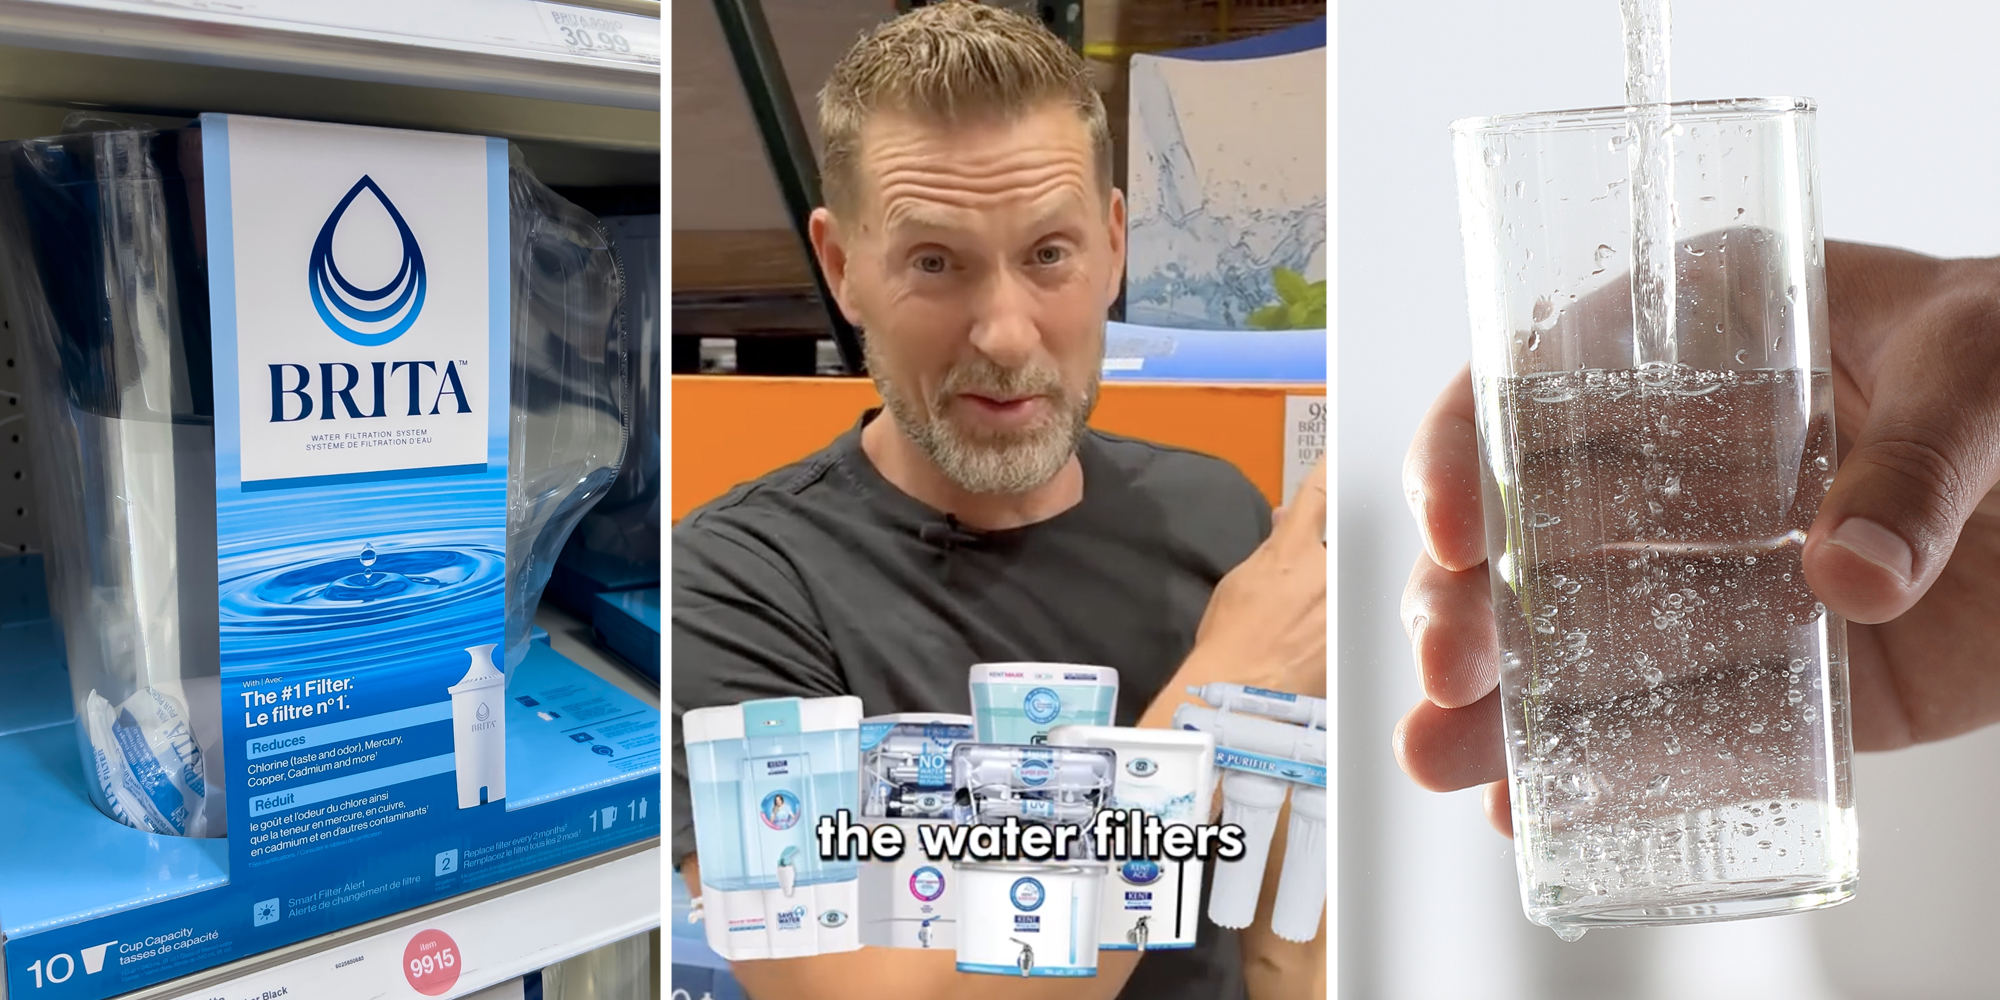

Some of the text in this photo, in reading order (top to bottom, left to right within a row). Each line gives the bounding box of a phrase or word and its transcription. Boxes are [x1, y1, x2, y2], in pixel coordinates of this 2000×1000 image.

[560, 26, 631, 52] 30.99
[306, 440, 345, 451] SYSTÈME
[348, 440, 358, 448] DE
[361, 438, 407, 447] FILTRATION
[311, 429, 427, 442] WATER FILTRATION SYSTEM
[242, 680, 260, 688] With
[265, 676, 283, 684] Avec
[240, 690, 278, 708] The
[281, 684, 301, 701] #1
[246, 712, 268, 728] Le
[272, 704, 313, 723] filtre
[248, 735, 403, 775] Chlorine (taste and odor), Mercury,
[252, 736, 306, 754] Reduces
[98, 748, 110, 781] FILTER
[247, 773, 286, 787] Copper,
[288, 763, 332, 779] Cadmium
[334, 758, 351, 769] and
[920, 755, 944, 768] NO
[1228, 754, 1276, 771] PURIFIER
[250, 791, 389, 832] le goût et l'odeur du chlore ainsi
[255, 793, 295, 812] Réduit
[627, 800, 635, 821] 1
[250, 801, 406, 845] que la teneur en mercure, en cuivre,
[589, 810, 598, 832] 1
[250, 847, 263, 857] en
[264, 836, 308, 854] cadmium
[310, 834, 319, 842] et
[320, 830, 332, 840] en
[333, 820, 368, 836] d'autres
[463, 846, 495, 860] Replace
[496, 840, 511, 852] filter
[512, 834, 532, 846] every
[533, 832, 539, 841] 2
[442, 859, 450, 871] 2
[463, 852, 506, 869] Remplacez
[506, 850, 512, 858] le
[514, 844, 529, 856] filtre
[529, 841, 546, 852] tous
[546, 838, 556, 847] les
[288, 879, 365, 908] Smart Filter Alert
[288, 875, 421, 919] Alerte de changement de filtre
[119, 927, 194, 954] Cup Capacity
[120, 930, 219, 966] tasses de capacité
[419, 940, 437, 951] item
[27, 953, 74, 989] 10
[410, 948, 455, 978] 9915
[262, 986, 288, 1000] Black
